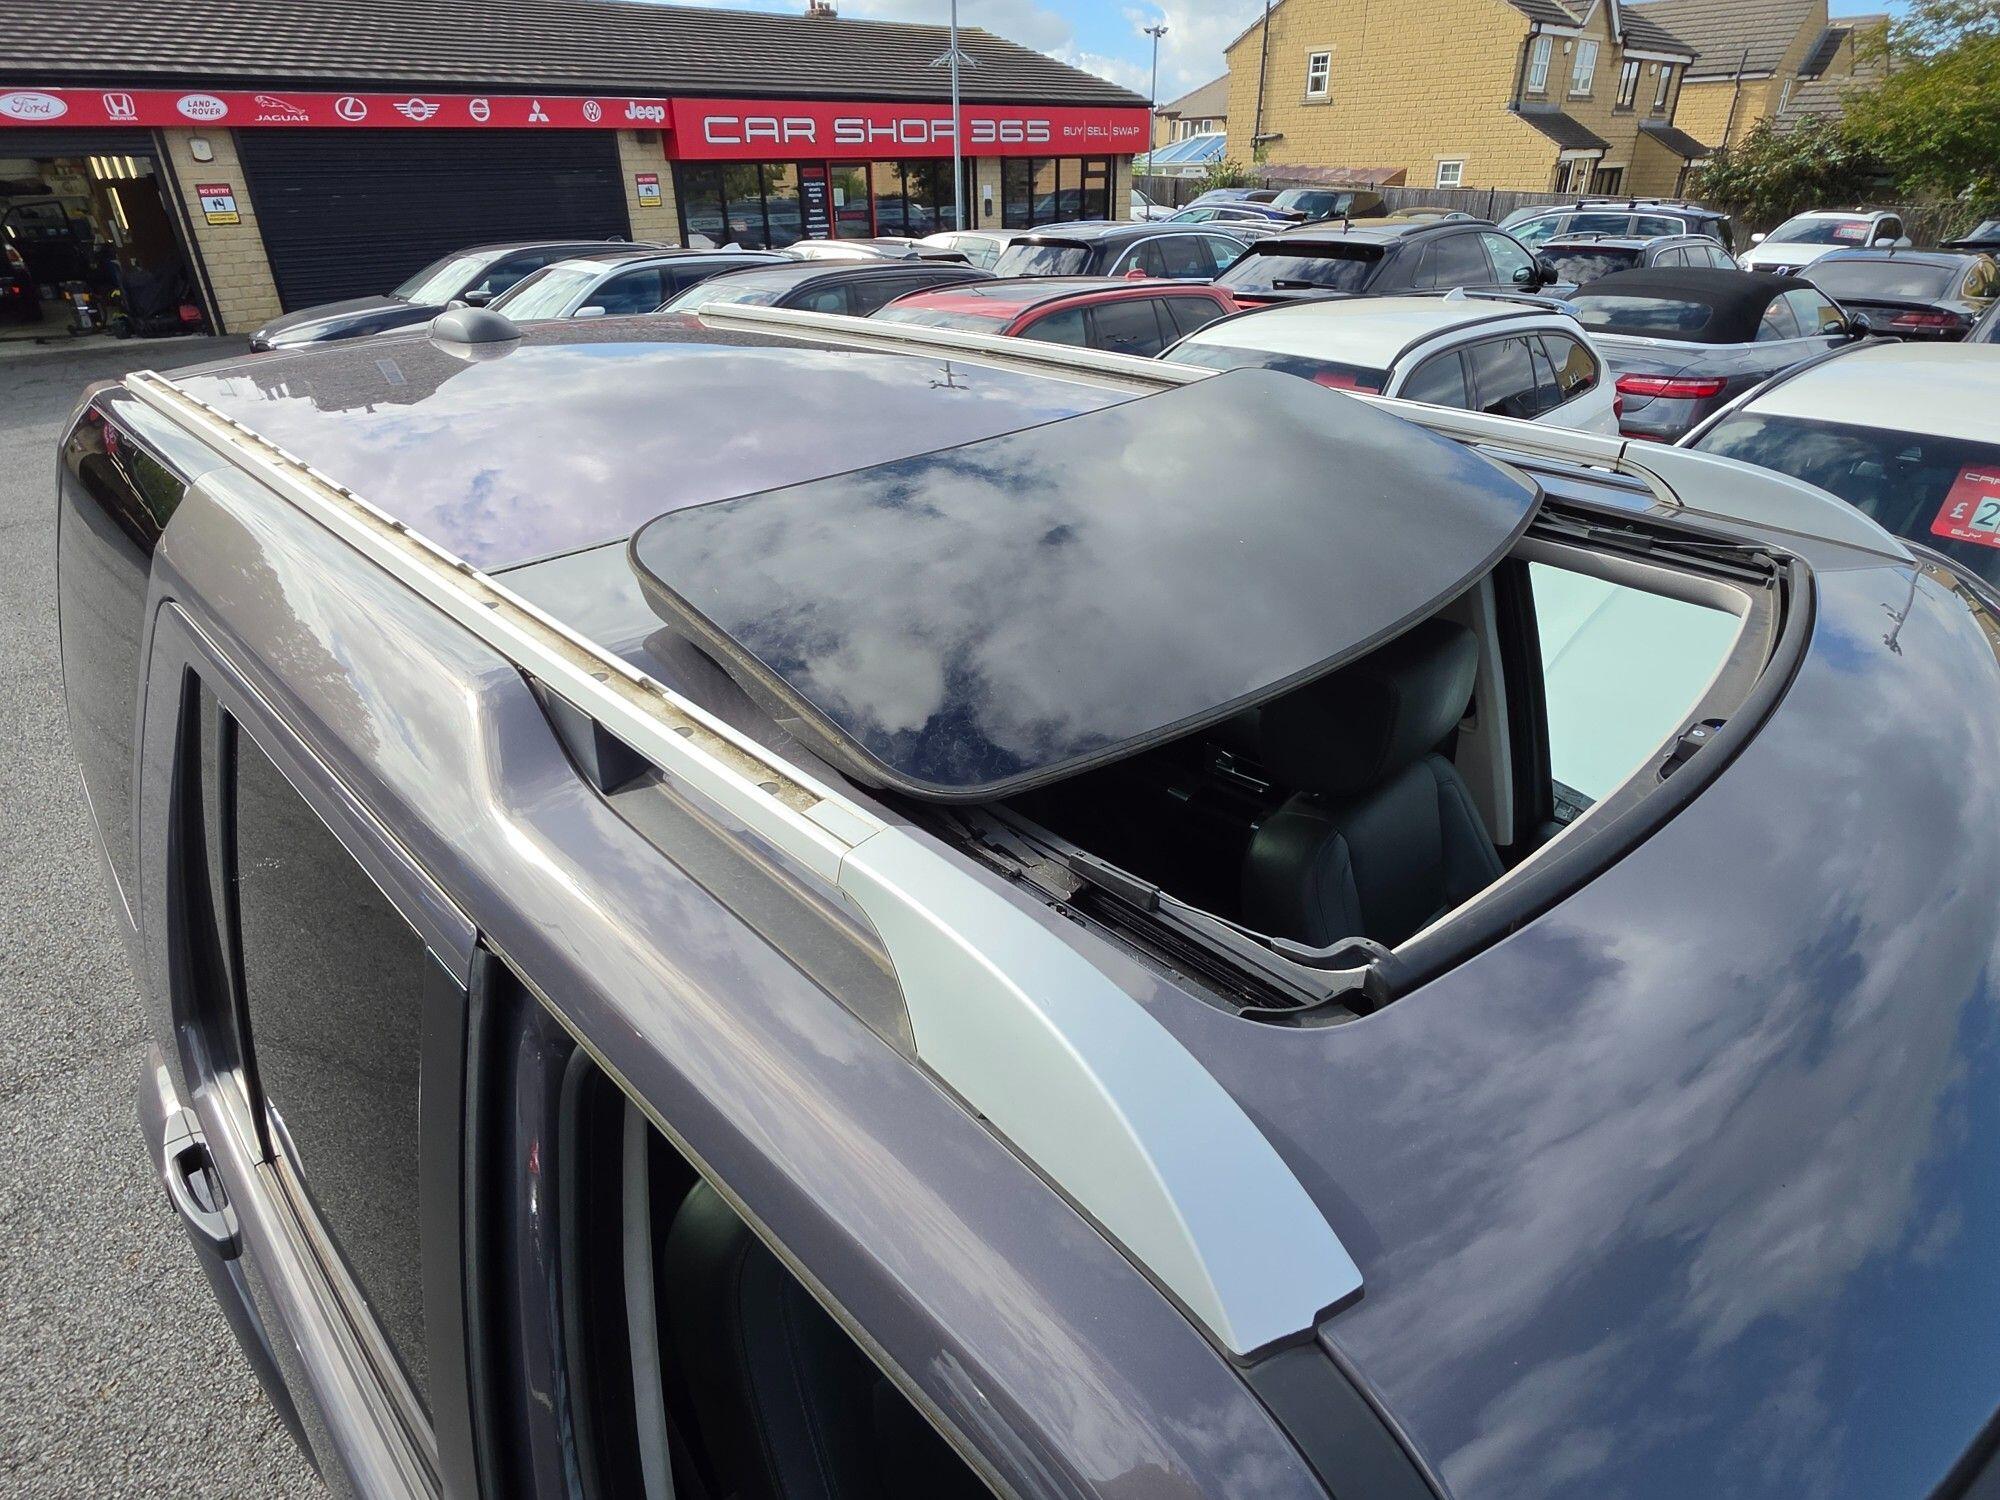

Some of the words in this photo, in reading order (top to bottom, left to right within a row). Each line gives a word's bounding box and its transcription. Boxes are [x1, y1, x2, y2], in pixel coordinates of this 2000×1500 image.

[11, 97, 52, 114] Ford
[625, 101, 665, 123] Jeep
[255, 114, 309, 122] JAGUAR
[704, 116, 816, 143] CAR
[834, 118, 958, 143] SHOP
[971, 120, 1050, 142] 365
[1063, 126, 1082, 136] BUY
[1087, 127, 1108, 136] SELL
[1112, 127, 1140, 136] SWAP
[1951, 528, 1982, 538] BUY
